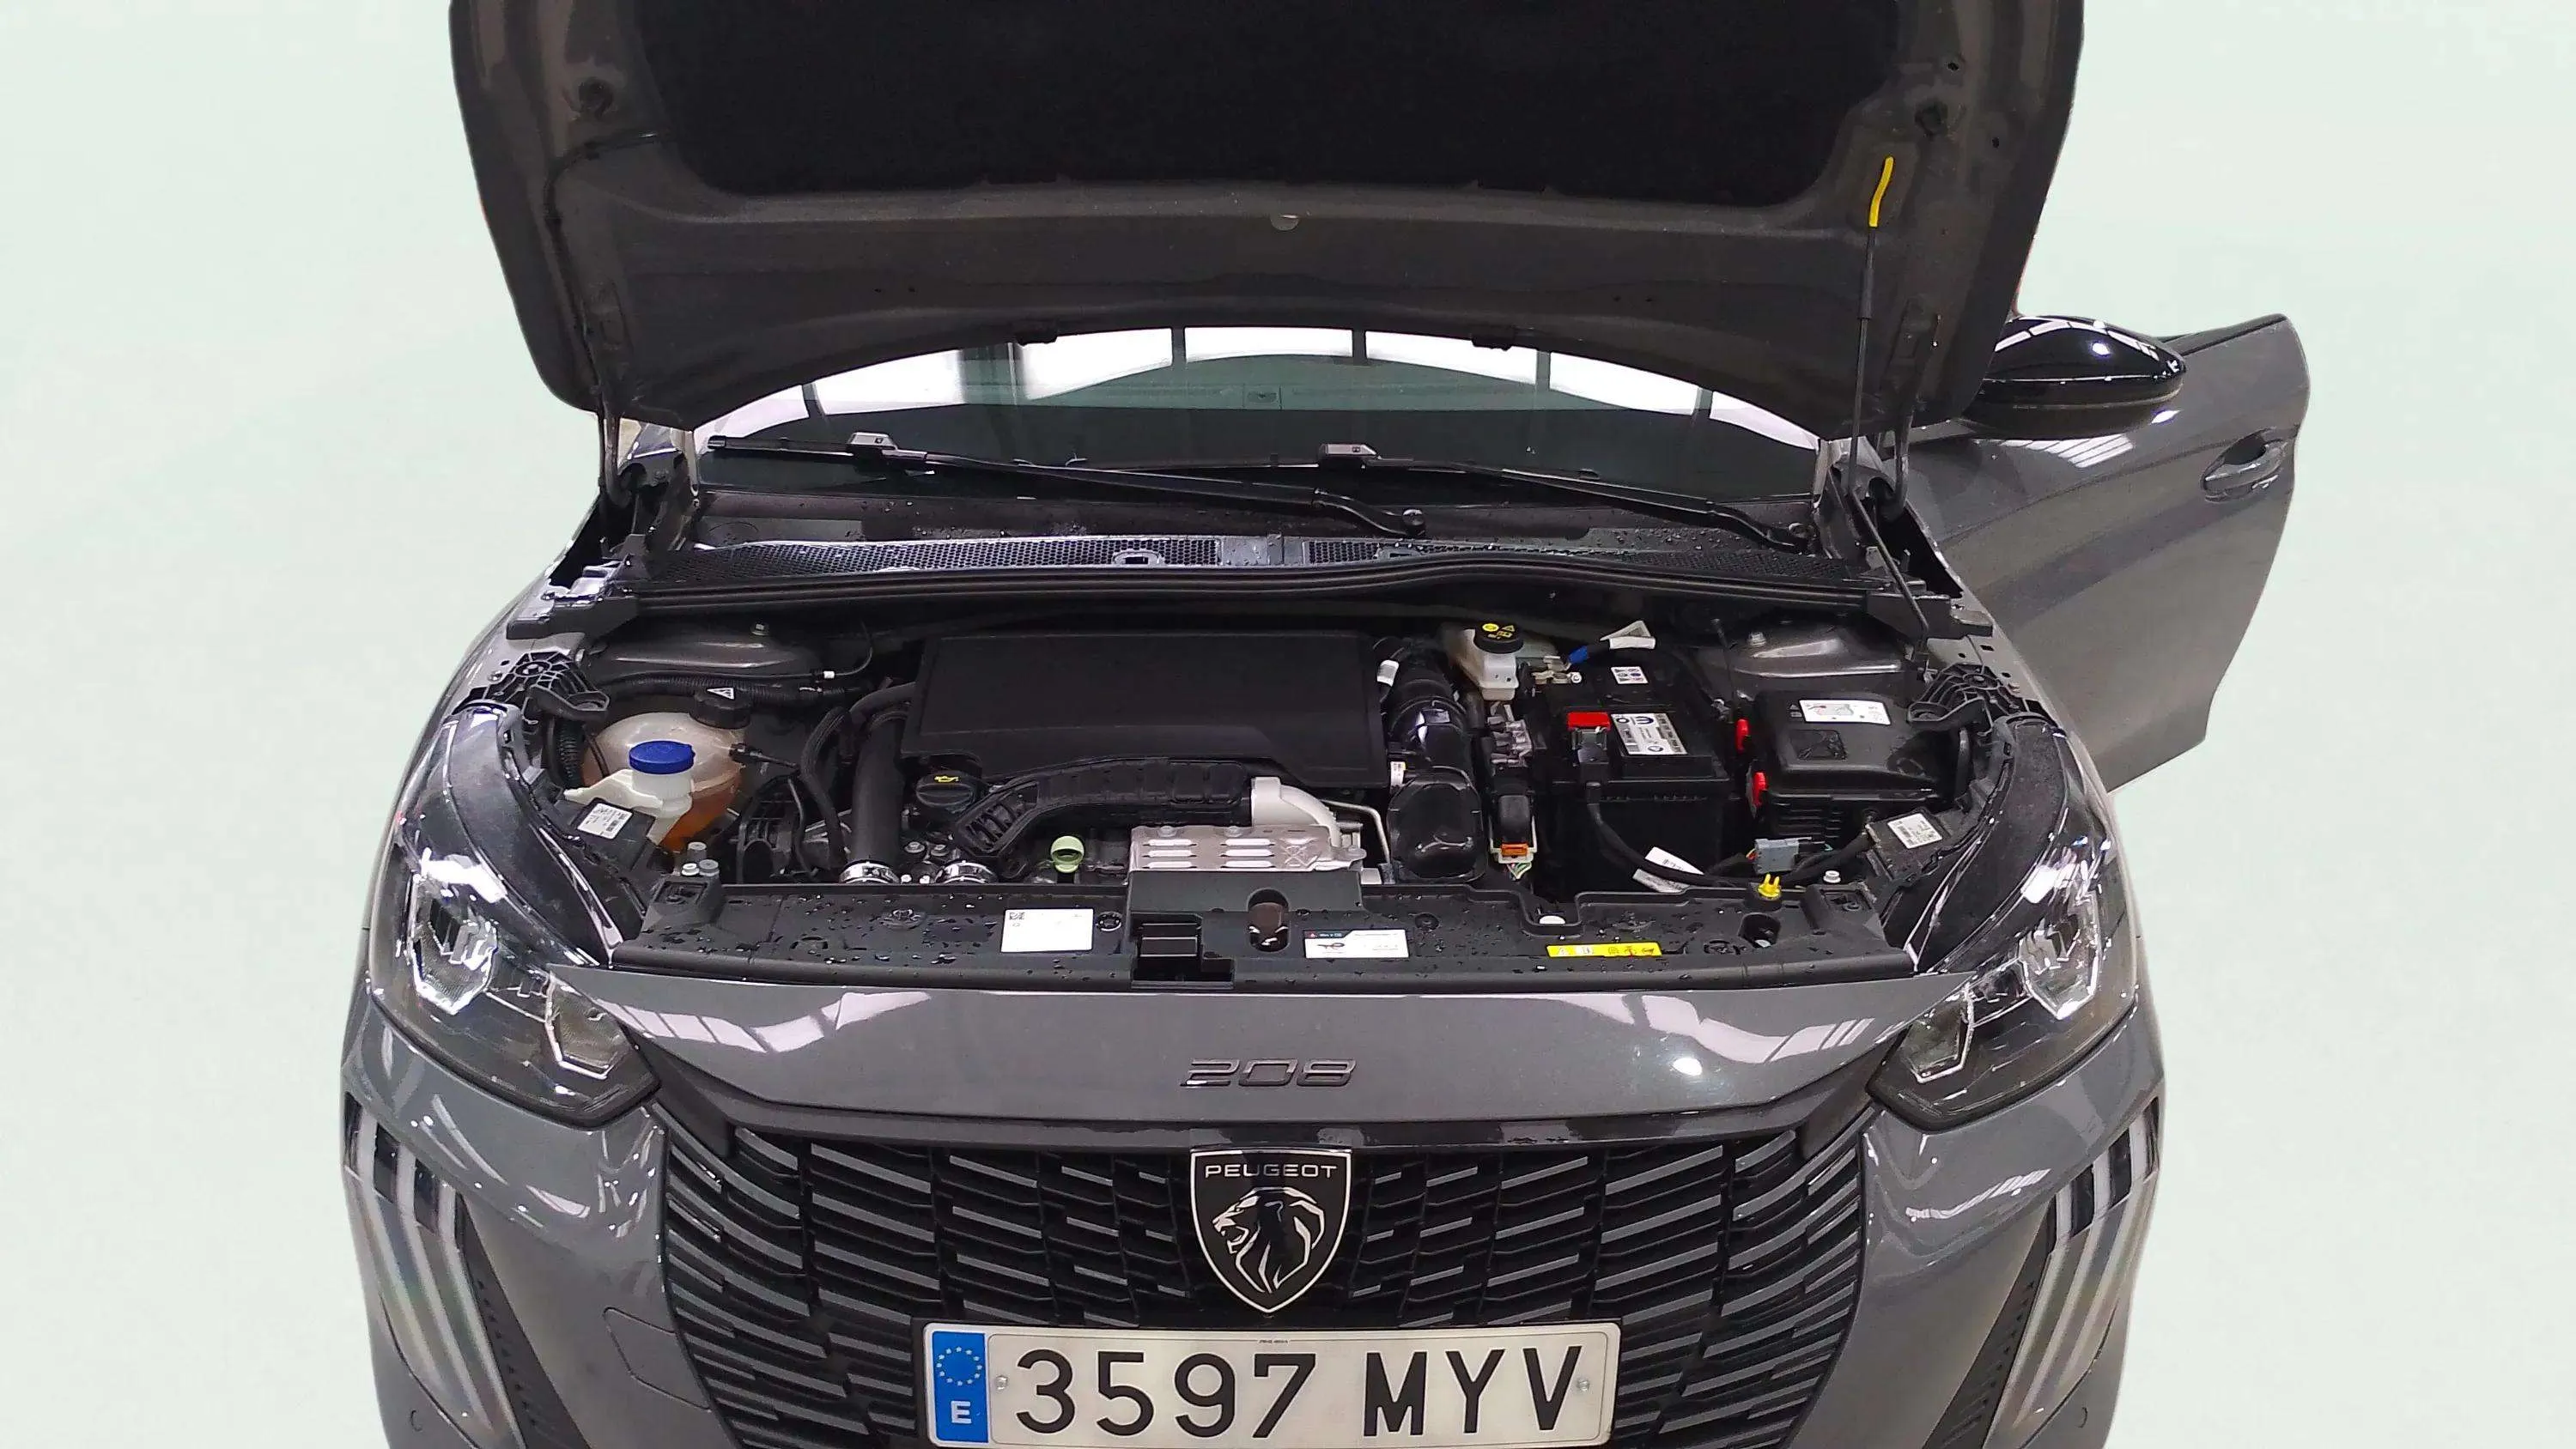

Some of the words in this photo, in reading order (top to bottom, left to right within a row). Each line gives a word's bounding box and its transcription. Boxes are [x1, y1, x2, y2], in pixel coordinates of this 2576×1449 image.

[1181, 1058, 1356, 1088] 208
[1205, 1163, 1338, 1179] PEUGEOT
[1016, 1349, 1316, 1439] 3597
[1363, 1345, 1583, 1437] MYV
[951, 1400, 972, 1424] E
